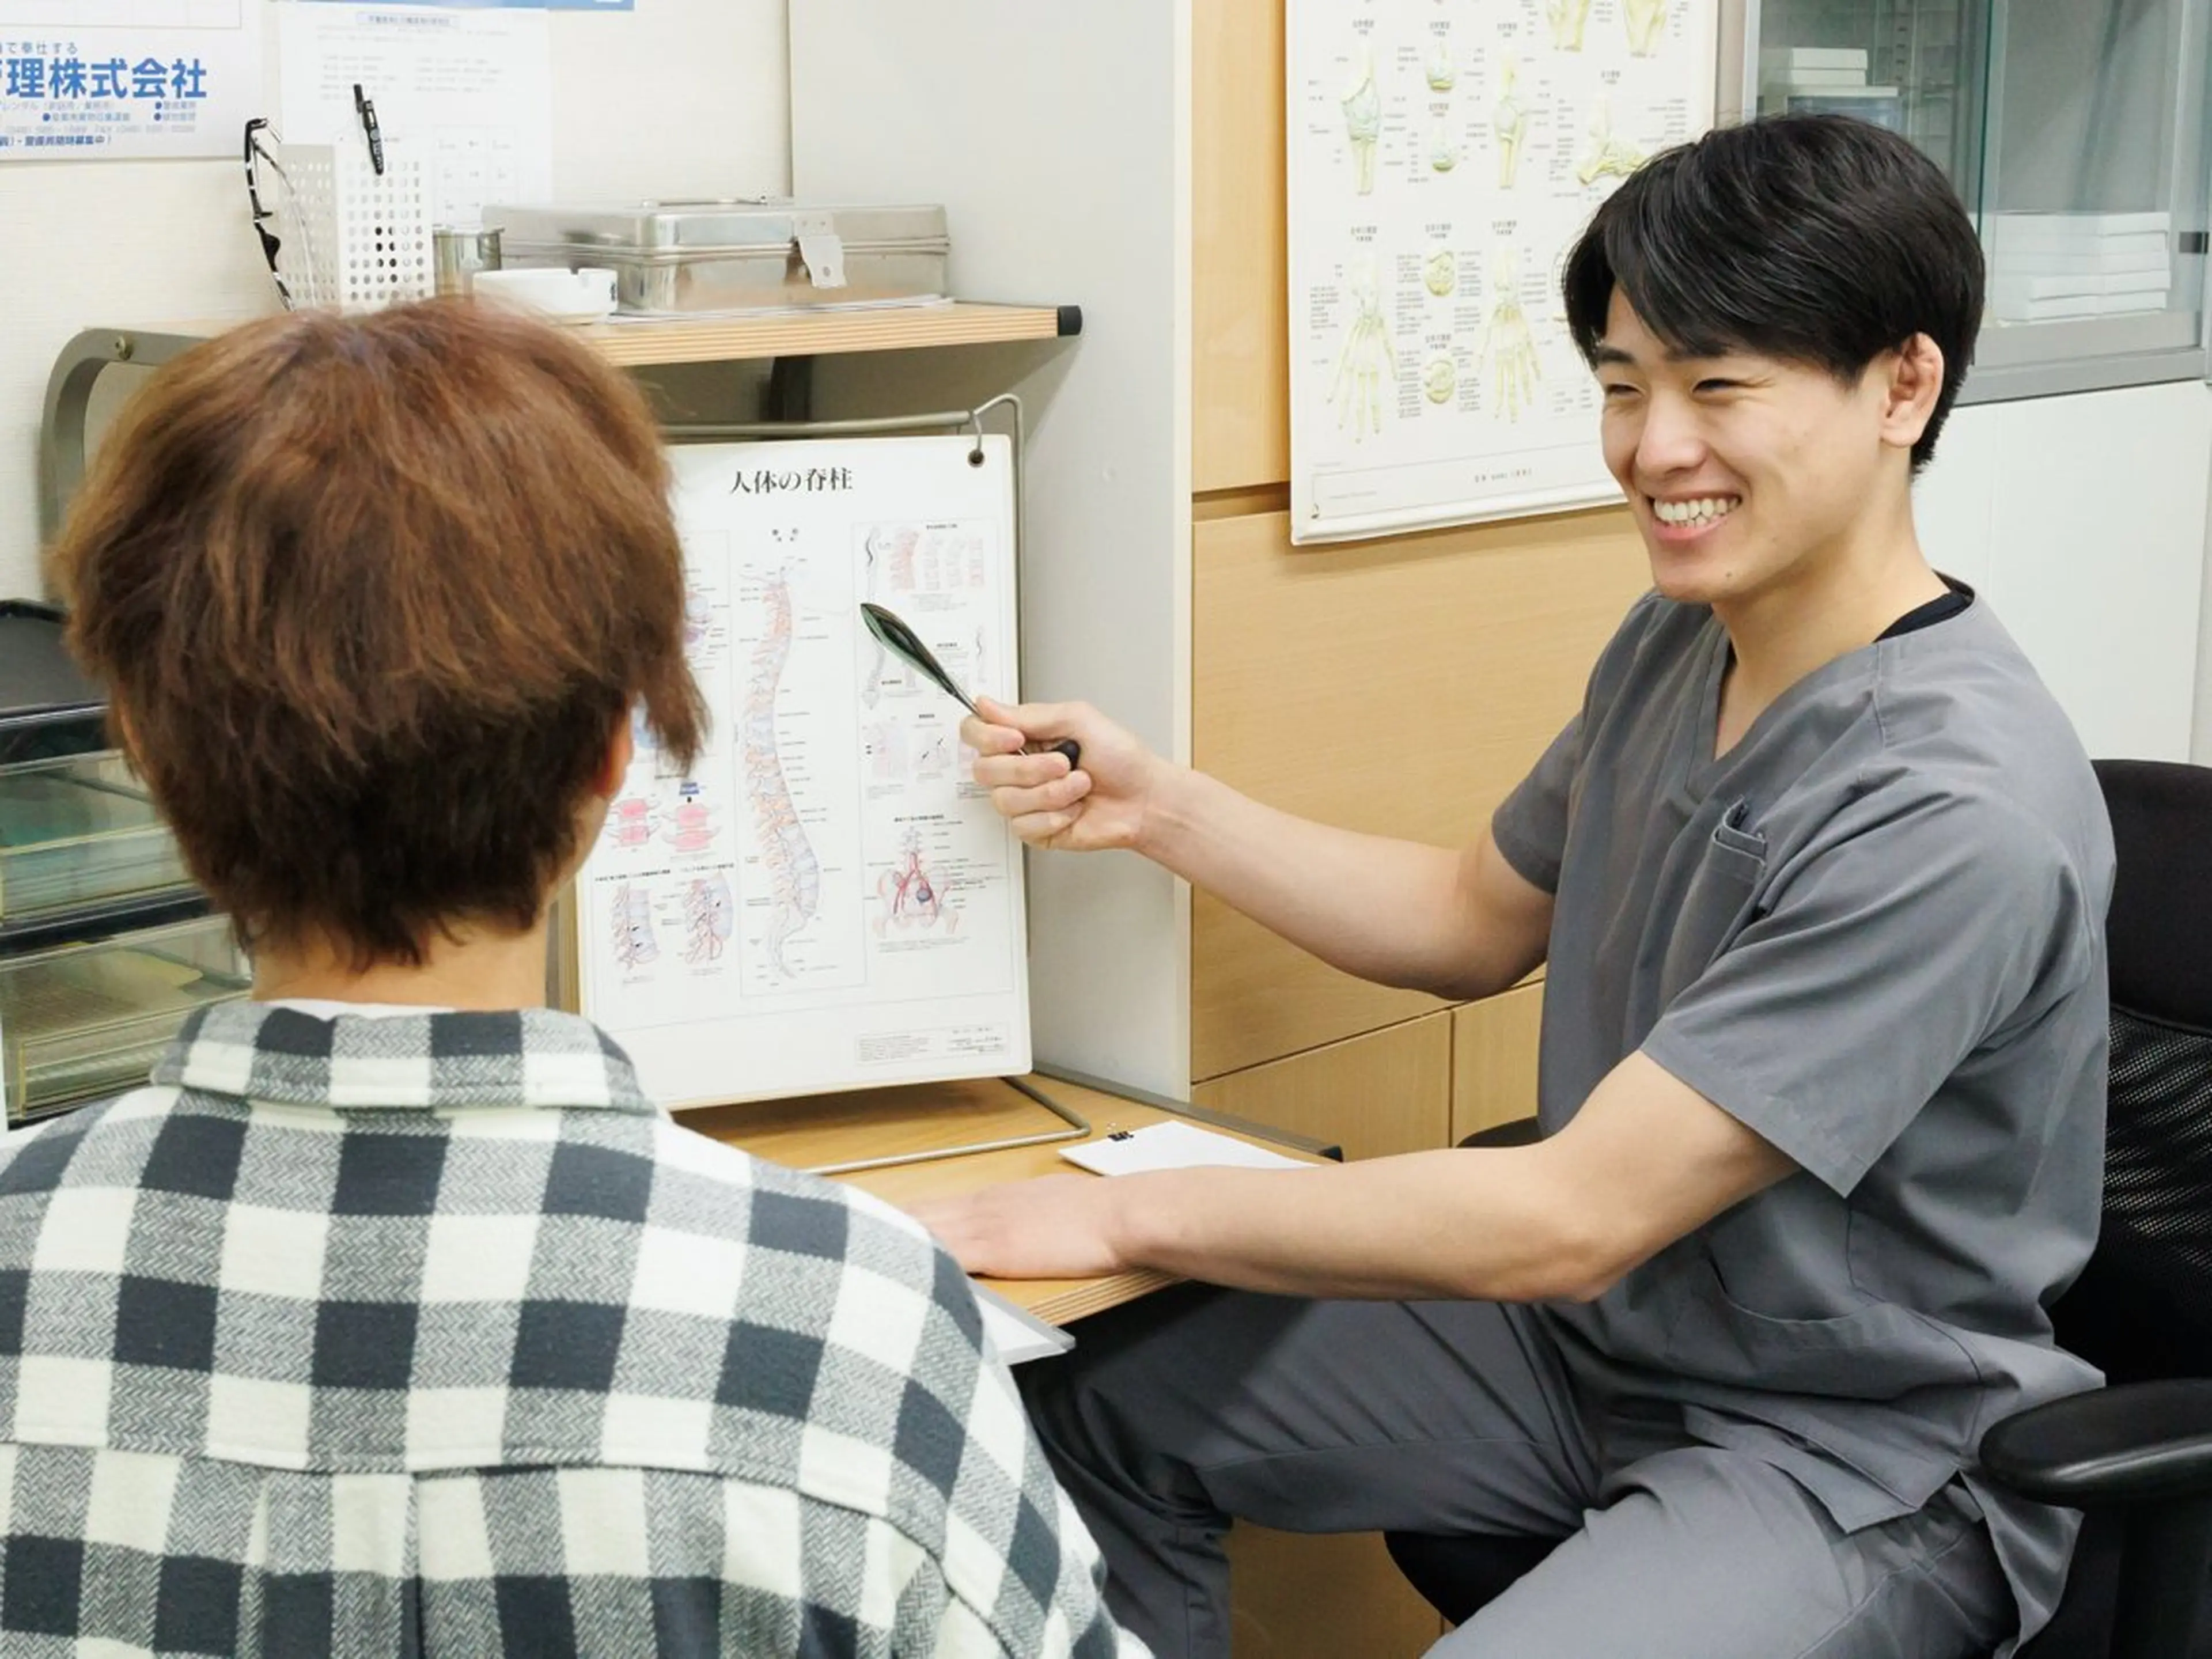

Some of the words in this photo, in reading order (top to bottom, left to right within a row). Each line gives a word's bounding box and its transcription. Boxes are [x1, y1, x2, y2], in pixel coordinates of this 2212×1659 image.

[0, 41, 78, 55] て奉仕する
[0, 57, 207, 99] 理株式会社
[729, 467, 854, 494] 人体の脊柱
